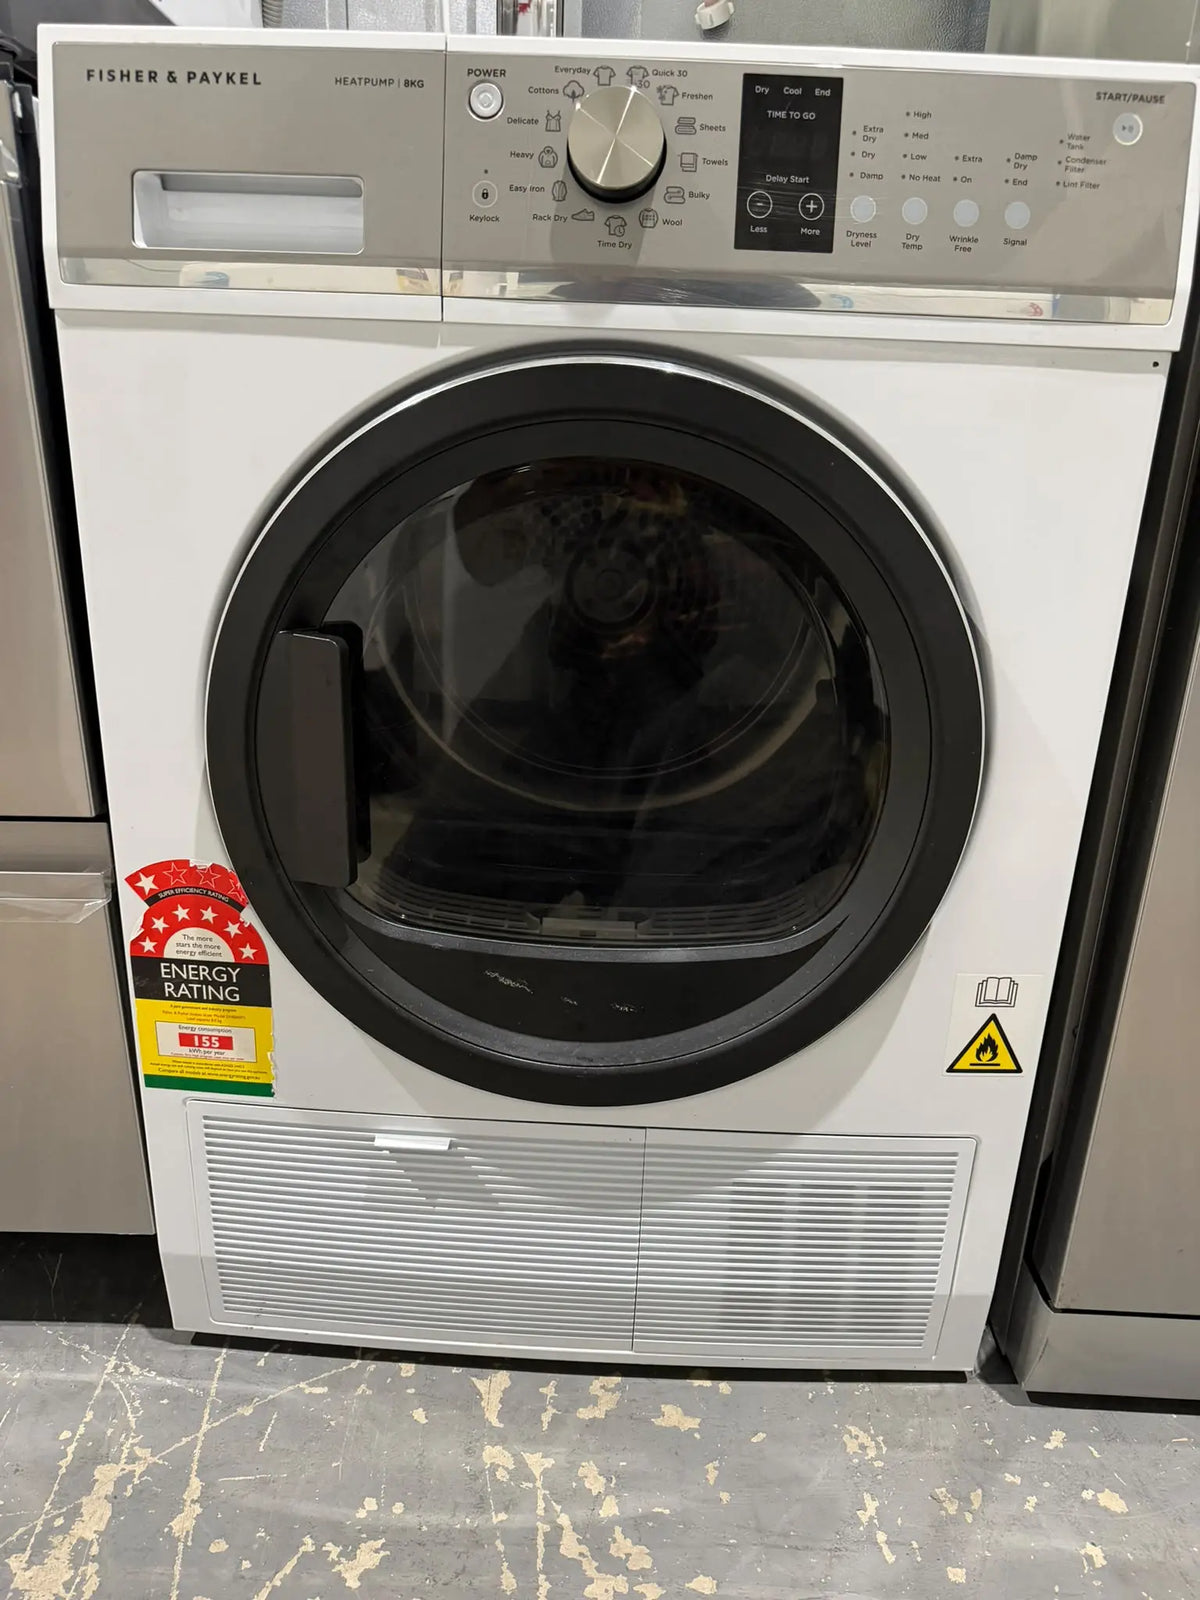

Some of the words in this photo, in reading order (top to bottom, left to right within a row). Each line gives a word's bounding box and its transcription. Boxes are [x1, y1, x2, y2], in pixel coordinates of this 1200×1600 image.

[467, 68, 506, 78] POWER
[554, 65, 591, 75] Everyday
[652, 69, 674, 77] Quick
[677, 69, 688, 78] 30
[86, 69, 158, 83] FISHER
[167, 70, 178, 83] &
[187, 71, 262, 85] PAYKEL
[335, 77, 395, 87] HEATPUMP
[404, 79, 424, 89] 8KG
[528, 86, 559, 95] Cottons
[755, 86, 769, 95] Dry
[783, 86, 802, 95] Cool
[815, 88, 831, 97] End
[682, 92, 713, 100] Freshen
[1096, 91, 1165, 104] START/PAUSE
[767, 110, 787, 119] TIME
[789, 111, 801, 119] TO
[803, 112, 816, 120] GO
[913, 111, 932, 119] High
[507, 117, 539, 126] Delicate
[699, 123, 726, 132] Sheets
[863, 125, 884, 133] Extra
[862, 135, 877, 143] Dry
[912, 132, 929, 140] Med
[1068, 133, 1090, 142] Water
[1067, 142, 1084, 151] Tank
[510, 151, 534, 160] Heavy
[861, 151, 876, 160] Dry
[962, 155, 983, 163] Extra
[1014, 153, 1038, 162] Damp
[702, 158, 728, 166] Towels
[1065, 156, 1107, 166] Condenser
[1013, 162, 1028, 171] Dry
[1064, 165, 1085, 174] Filter
[766, 175, 788, 184] Delay
[790, 176, 809, 184] Start
[860, 172, 884, 181] Damp
[960, 176, 972, 184] On
[1012, 178, 1028, 187] End
[1063, 181, 1078, 189] Lint
[1080, 181, 1100, 190] Filter
[509, 184, 527, 193] Easy
[688, 191, 710, 200] Bulky
[469, 214, 500, 223] Keylock
[554, 214, 568, 223] Dry
[662, 218, 683, 226] Wool
[750, 225, 768, 233] Less
[801, 228, 820, 236] More
[846, 230, 877, 240] Dryness
[906, 233, 920, 242] Dry
[949, 235, 979, 244] Wrinkle
[597, 240, 616, 248] Time
[618, 241, 632, 250] Dry
[850, 240, 872, 248] Level
[902, 242, 923, 251] Temp
[1003, 238, 1027, 247] Signal
[954, 244, 972, 252] Free
[158, 889, 175, 899] SUPER
[175, 887, 207, 895] EFFICIENCY
[207, 891, 229, 903] RATING
[198, 950, 223, 958] efficient
[160, 962, 240, 983] ENERGY
[164, 982, 240, 1002] RATING
[198, 1026, 233, 1034] consumption
[194, 1035, 220, 1048] 155
